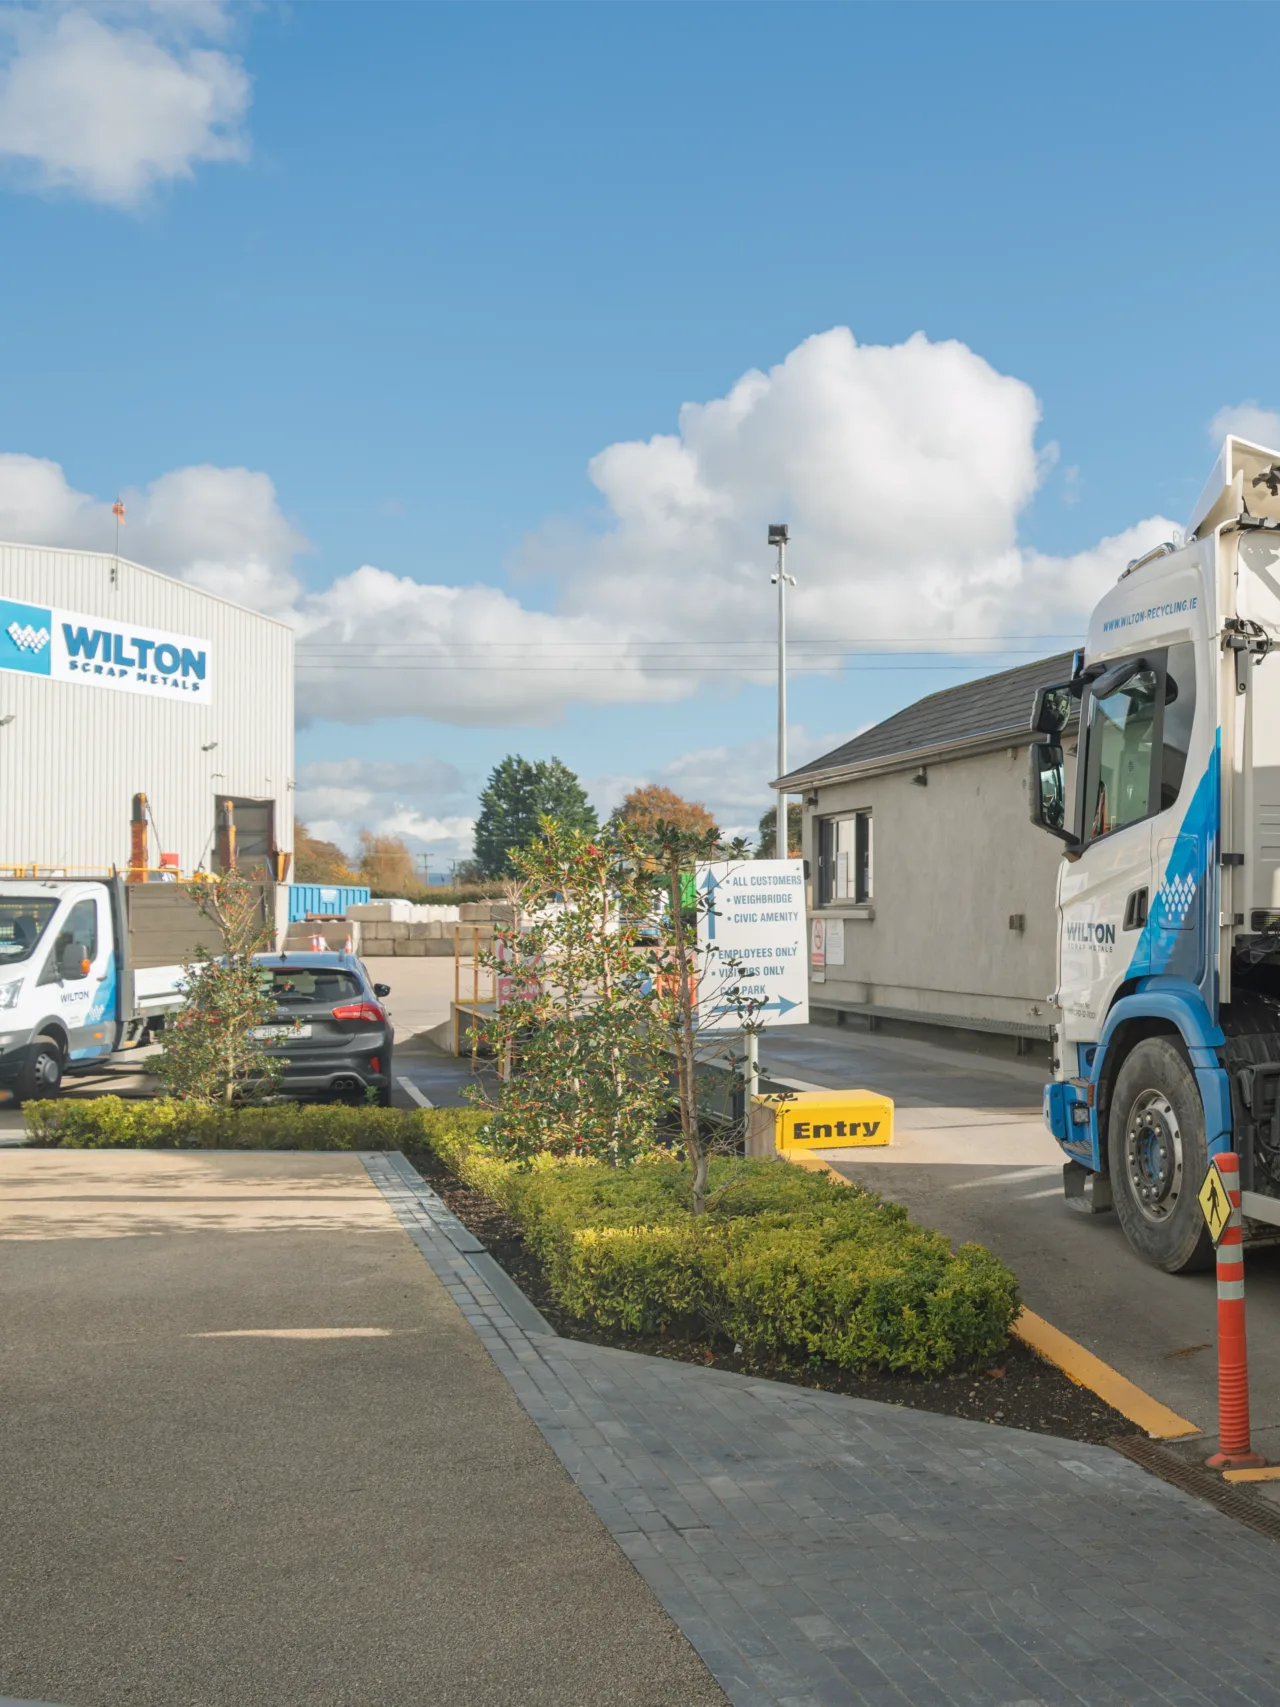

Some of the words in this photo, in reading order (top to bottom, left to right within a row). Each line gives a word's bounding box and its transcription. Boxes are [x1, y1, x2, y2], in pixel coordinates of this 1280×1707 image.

[1103, 597, 1198, 632] WWW.WILTON-RECYCLING.IE
[61, 623, 206, 680] WILTON
[69, 660, 128, 678] SCRAP
[137, 672, 200, 691] METALS
[732, 876, 748, 887] ALL
[750, 875, 802, 886] CUSTOMERS
[733, 893, 793, 905] WEIGHBRIDGE
[734, 912, 758, 924] CIVIC
[760, 911, 799, 922] AMENITY
[1066, 922, 1115, 945] WILTON
[718, 947, 773, 960] EMPLOYEES
[775, 946, 797, 957] ONLY
[763, 965, 785, 977] ONLY
[741, 984, 766, 995] PARK
[61, 990, 89, 1003] WILTON
[793, 1120, 881, 1140] Entry
